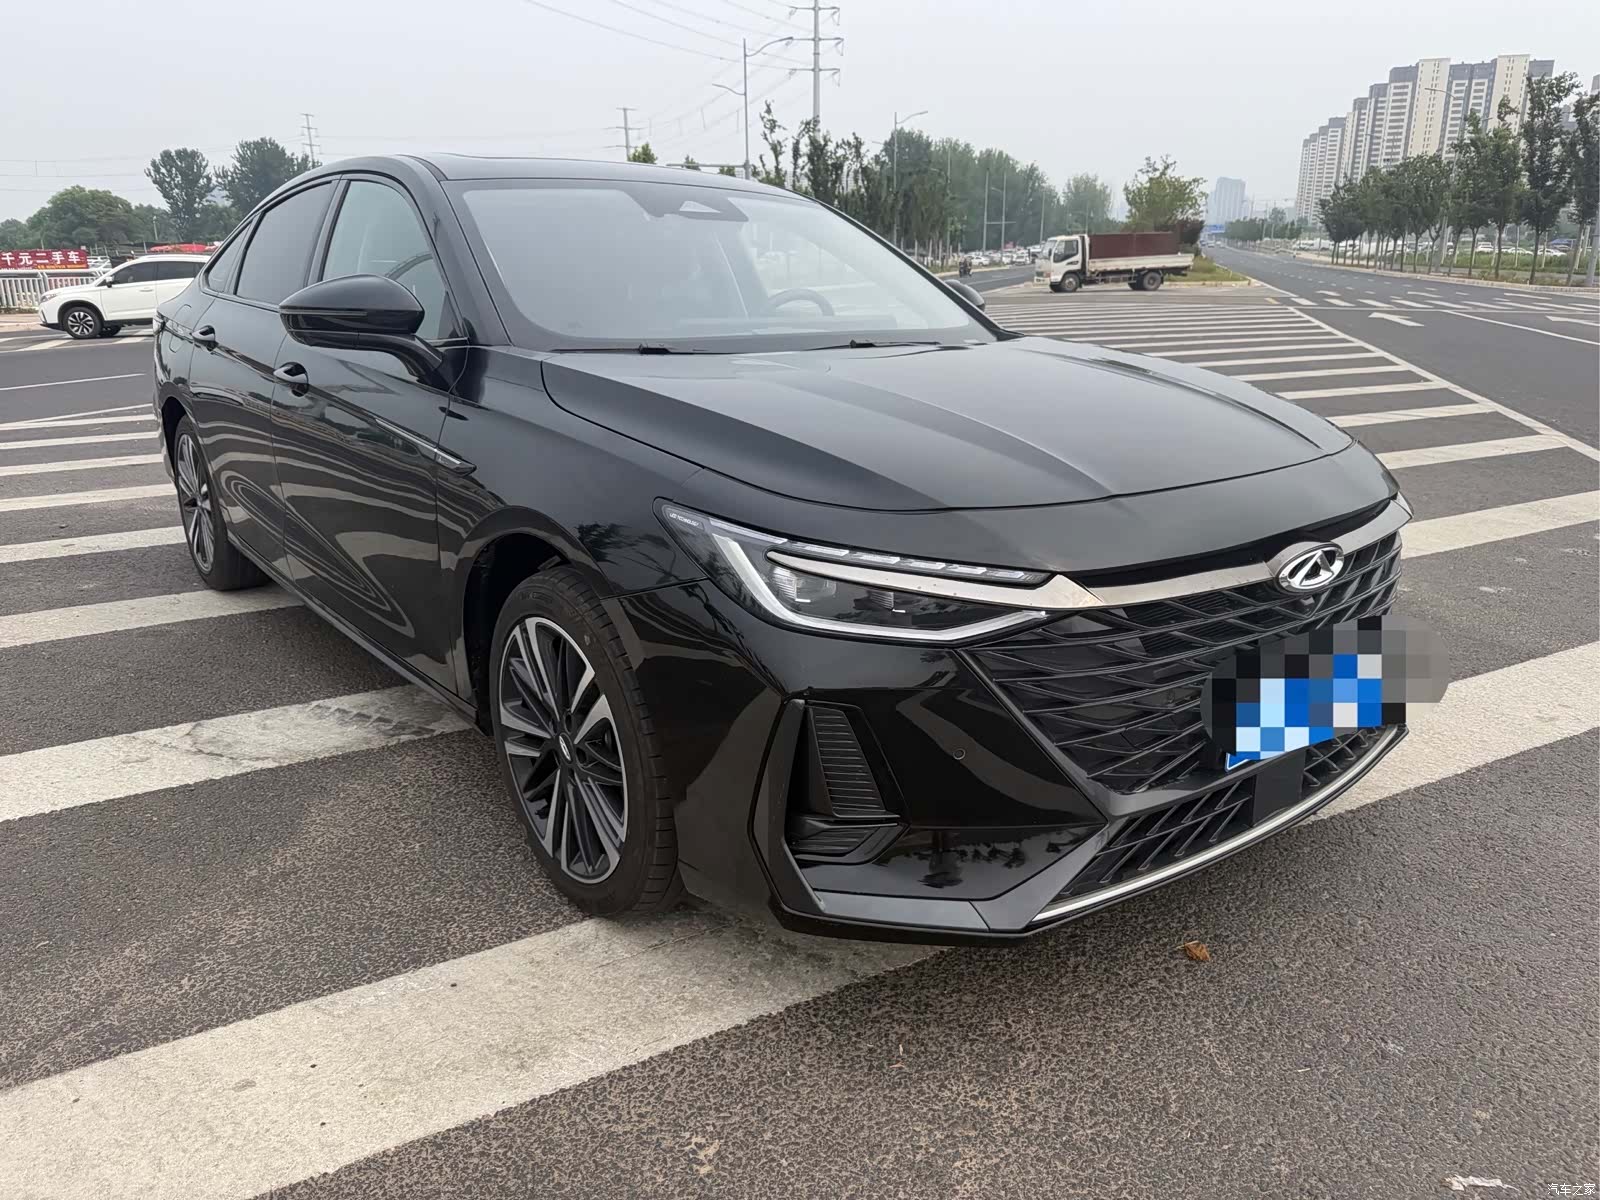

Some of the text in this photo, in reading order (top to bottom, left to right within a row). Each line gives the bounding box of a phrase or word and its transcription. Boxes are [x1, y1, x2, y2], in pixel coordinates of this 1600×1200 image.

[1, 251, 81, 266] 千元二手车
